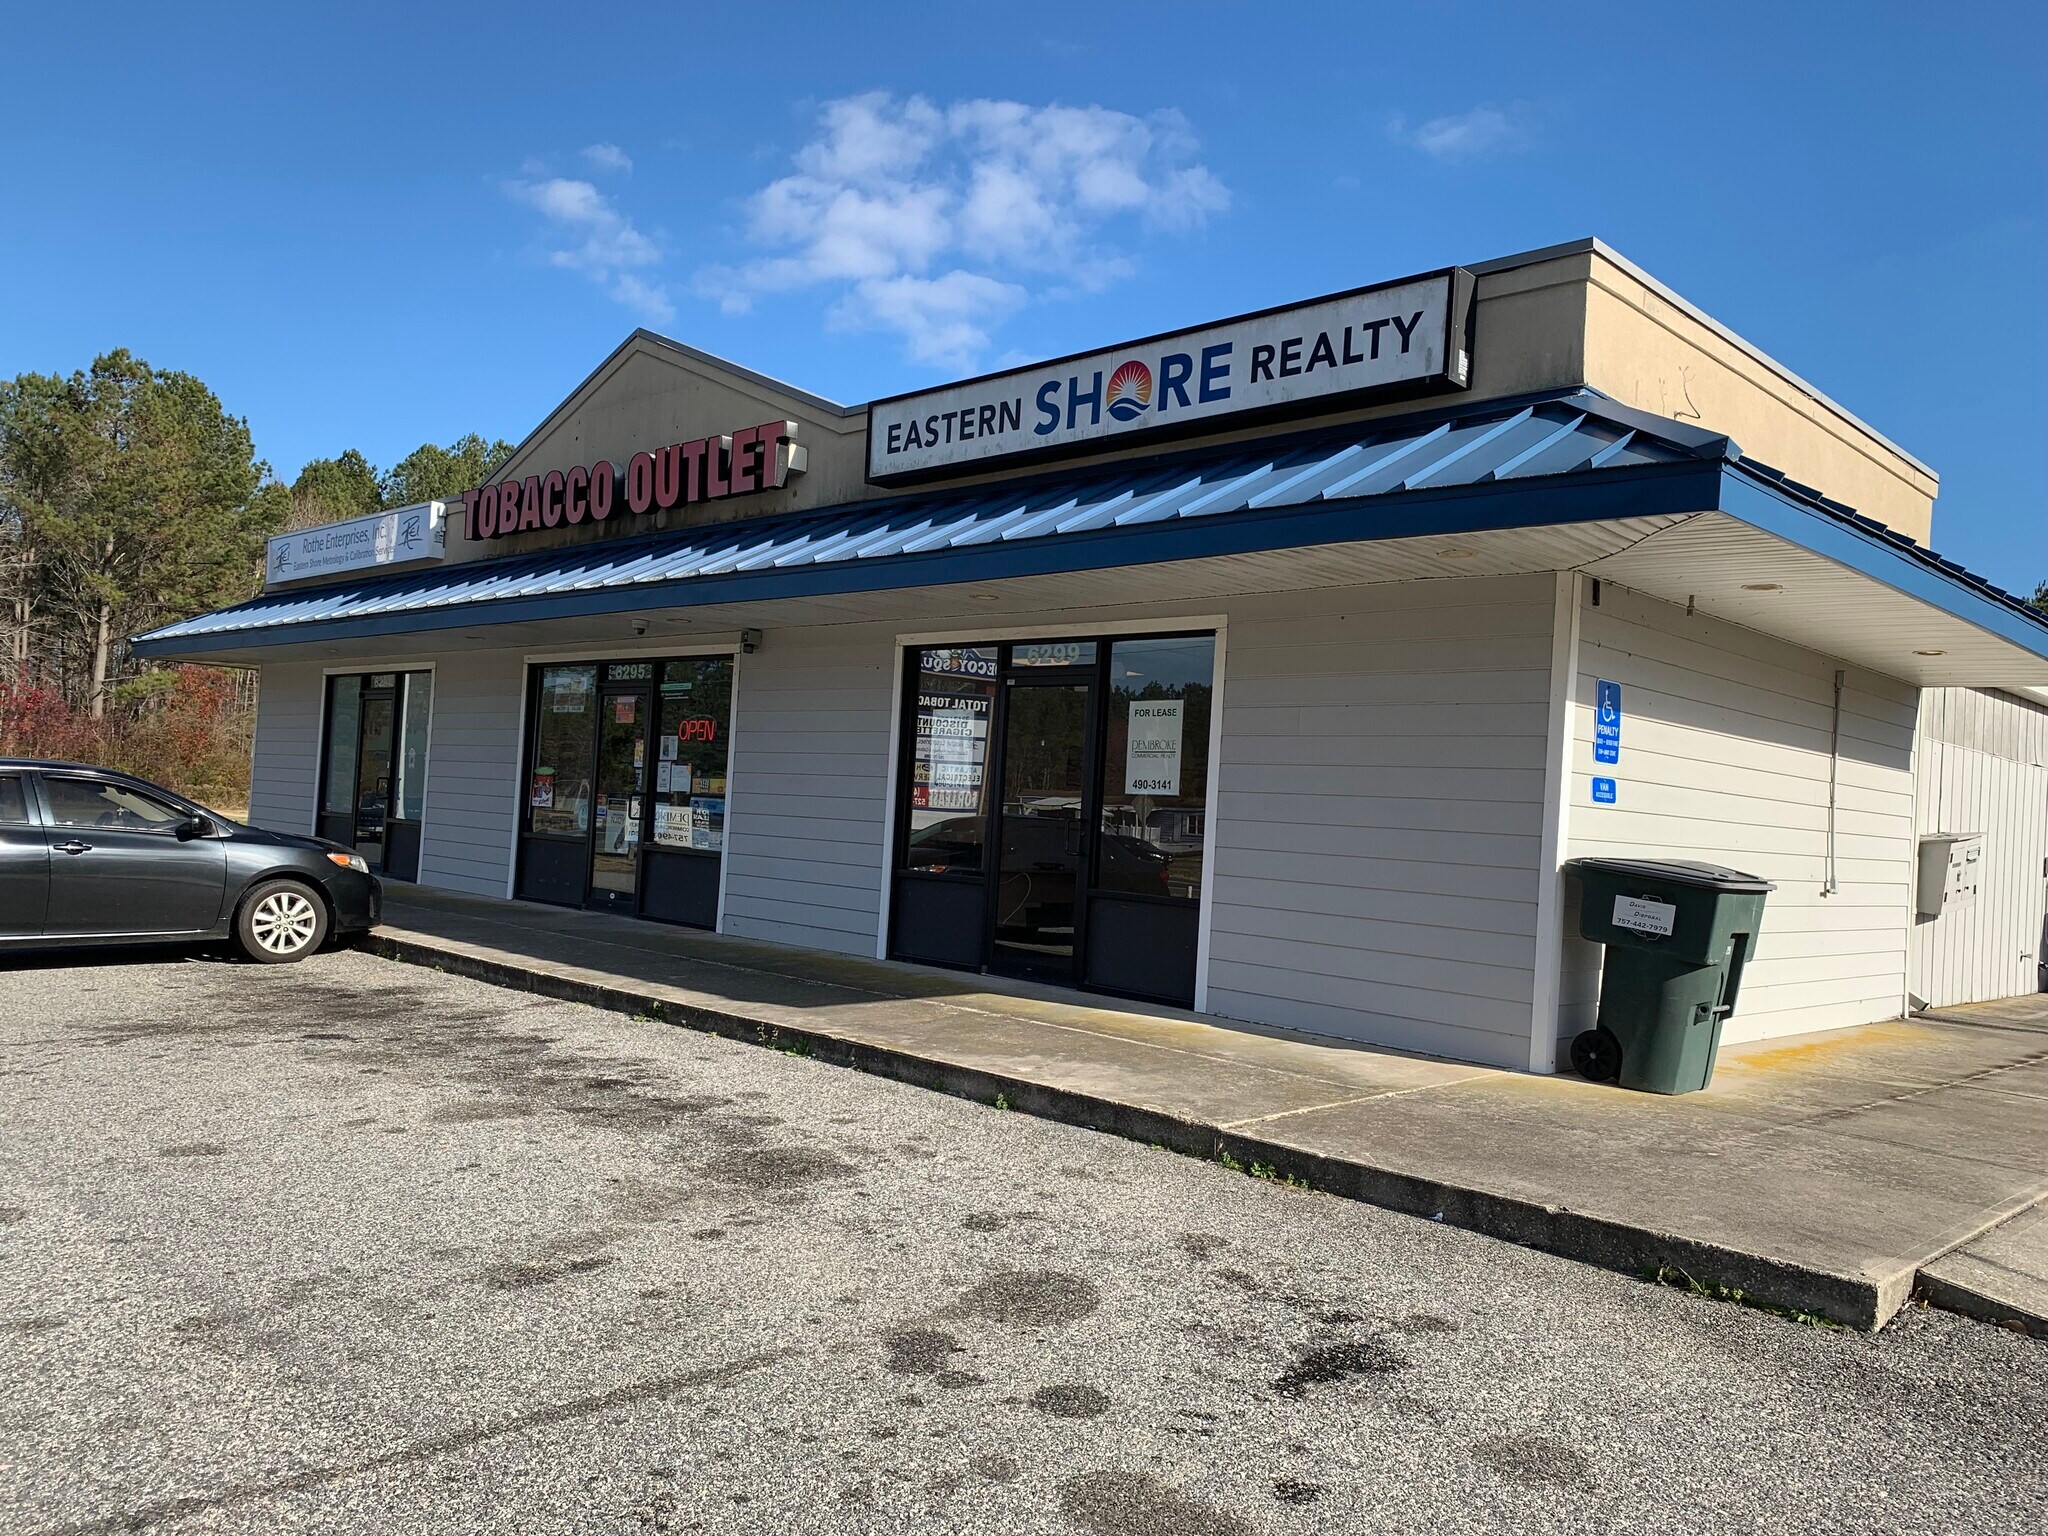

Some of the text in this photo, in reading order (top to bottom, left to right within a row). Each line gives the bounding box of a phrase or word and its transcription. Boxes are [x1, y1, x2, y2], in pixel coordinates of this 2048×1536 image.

[886, 397, 1021, 455] EASTERN
[1033, 341, 1233, 436] SHORE
[1250, 310, 1425, 384] REALTY
[461, 420, 785, 541] TOBACCO OUTLET
[302, 524, 387, 554] Rothe Enterprises, Inc.
[293, 558, 309, 571] Eastern
[309, 556, 322, 569] Shore
[322, 554, 344, 567] Metrology
[1027, 642, 1081, 664] 6299
[615, 663, 646, 680] 6295
[1134, 708, 1177, 717] FOR LEASE
[678, 719, 716, 741] OPEN
[1598, 724, 1619, 737] PENALTY
[1131, 739, 1177, 752] PEMBROKE
[1132, 778, 1172, 790] 490-3141
[1600, 782, 1609, 791] VAN
[1616, 917, 1669, 933] 757-442-7979
